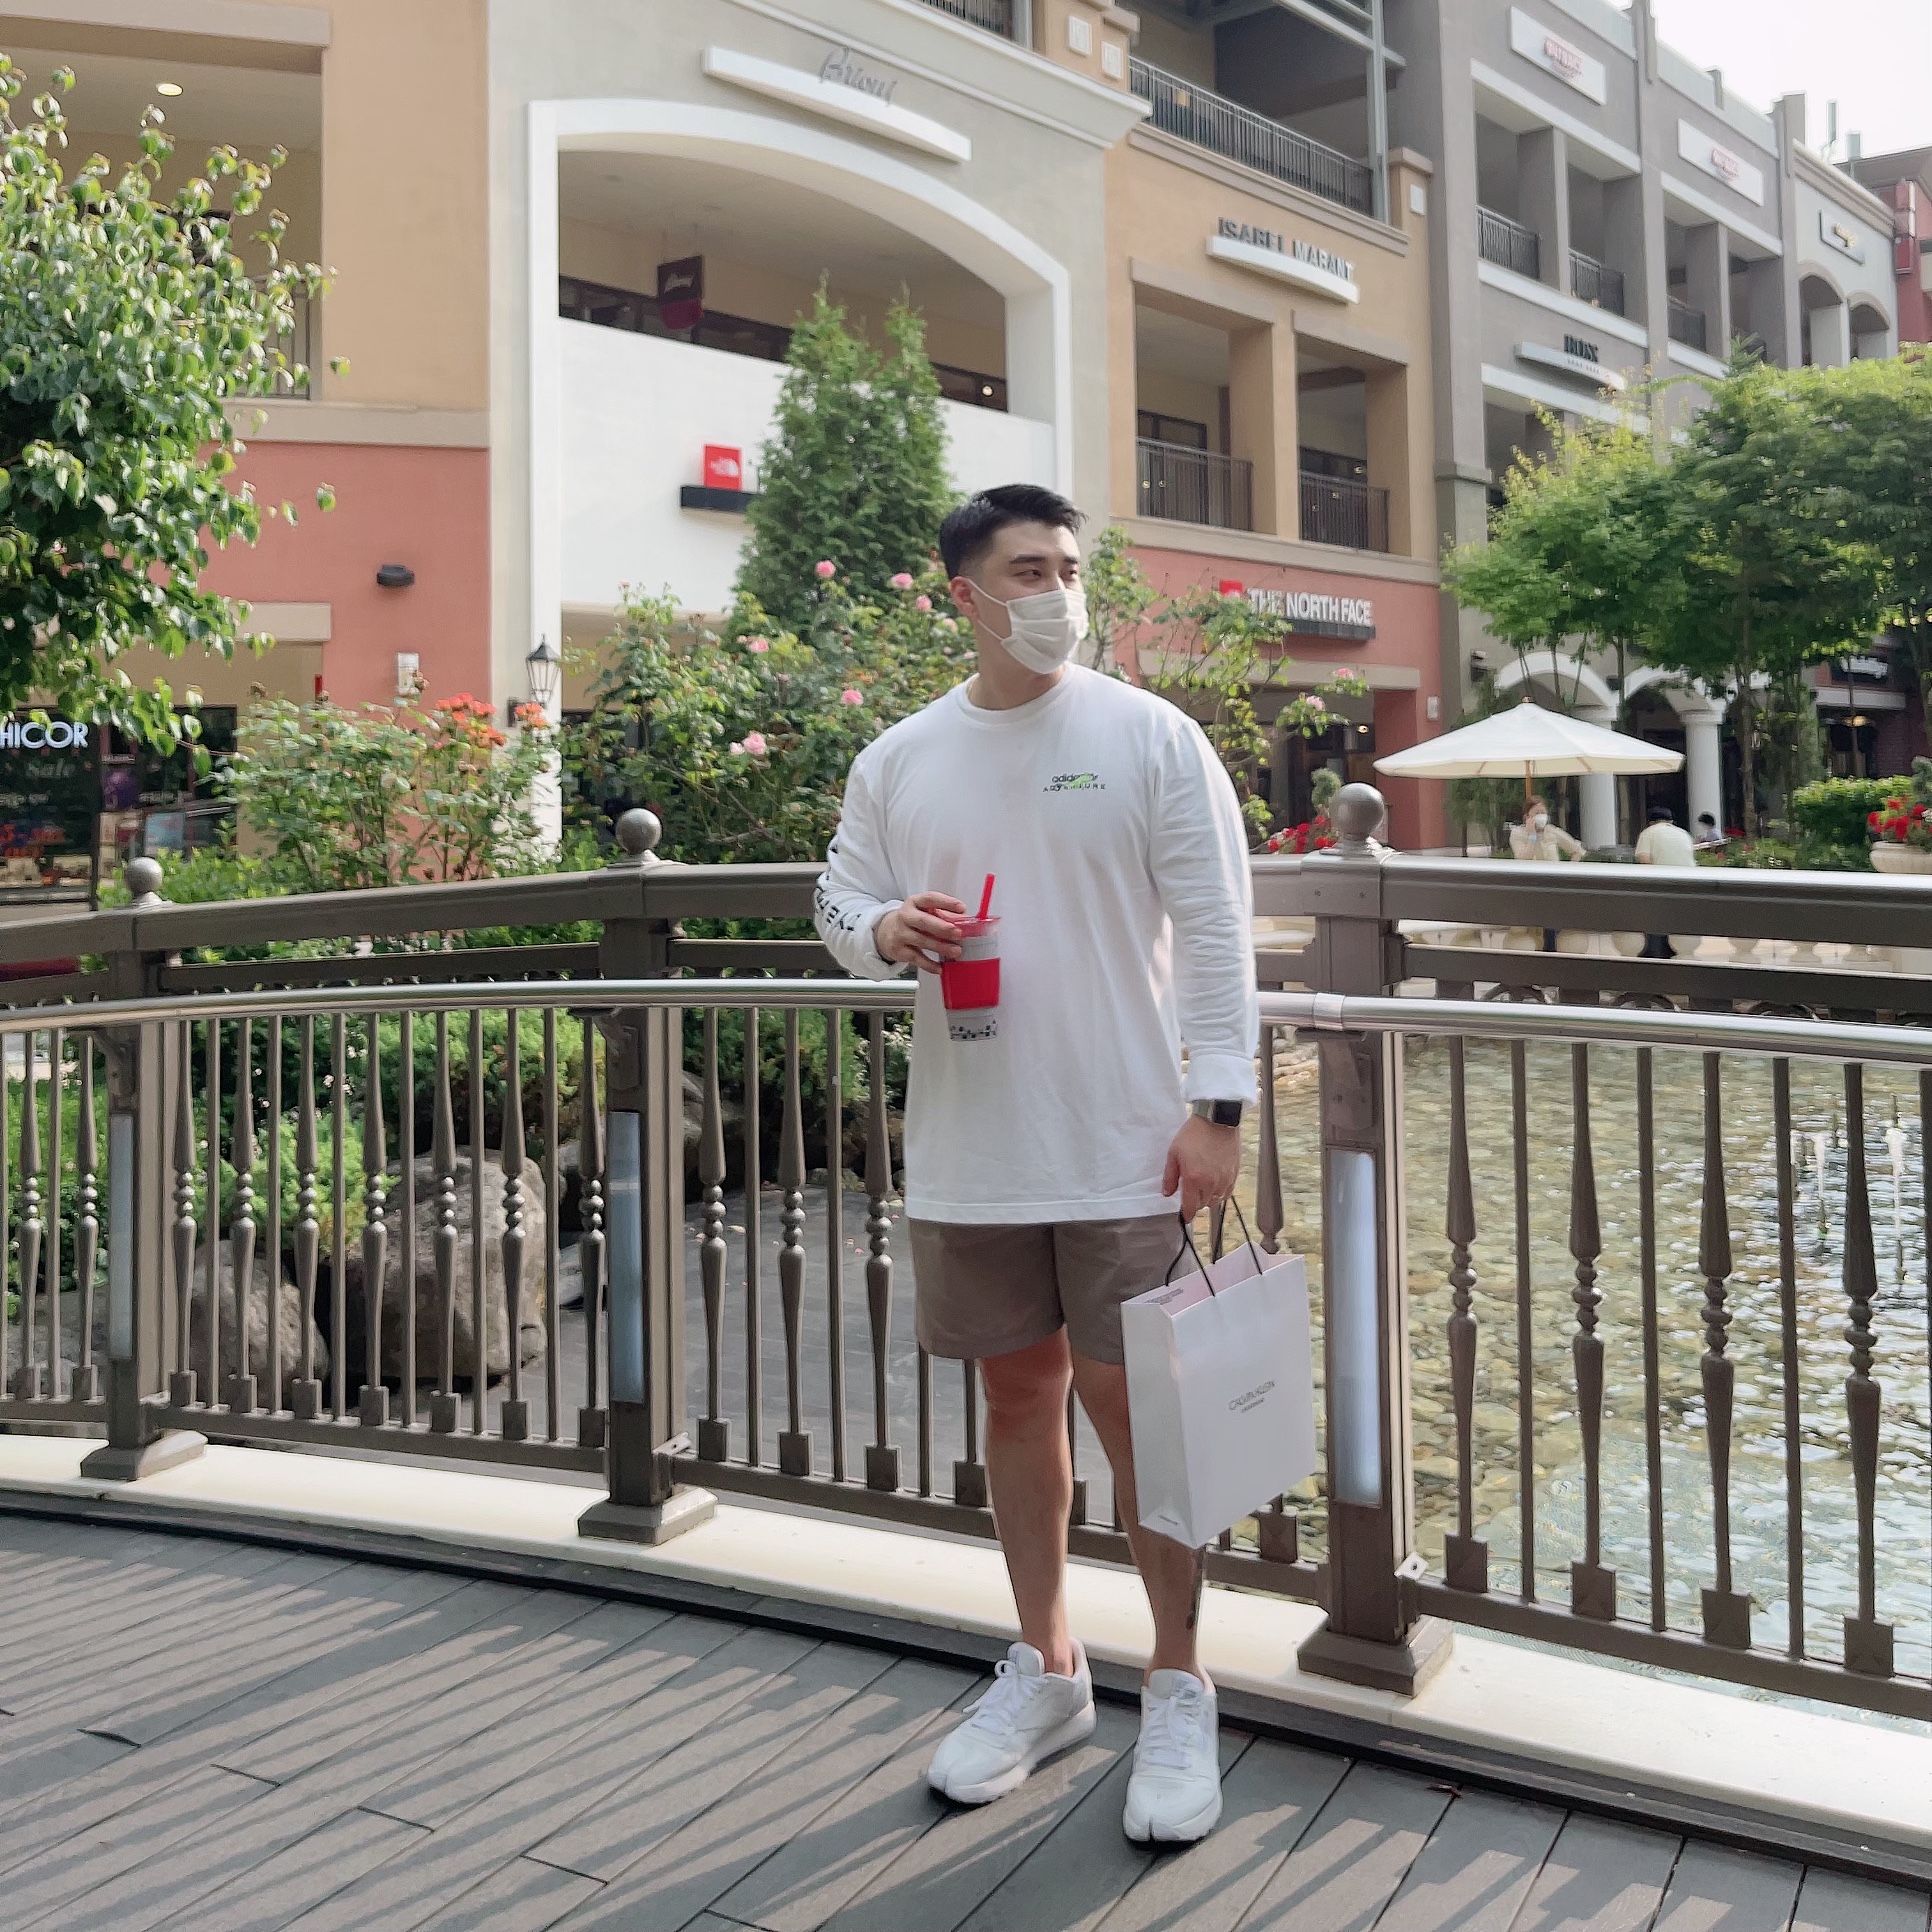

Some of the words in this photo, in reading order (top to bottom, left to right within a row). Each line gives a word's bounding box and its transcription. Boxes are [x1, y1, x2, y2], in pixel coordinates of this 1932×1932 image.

[1218, 217, 1284, 252] ISABEL
[1292, 239, 1354, 281] MARANT
[1286, 591, 1339, 622] NORTH
[1341, 597, 1373, 625] FACE
